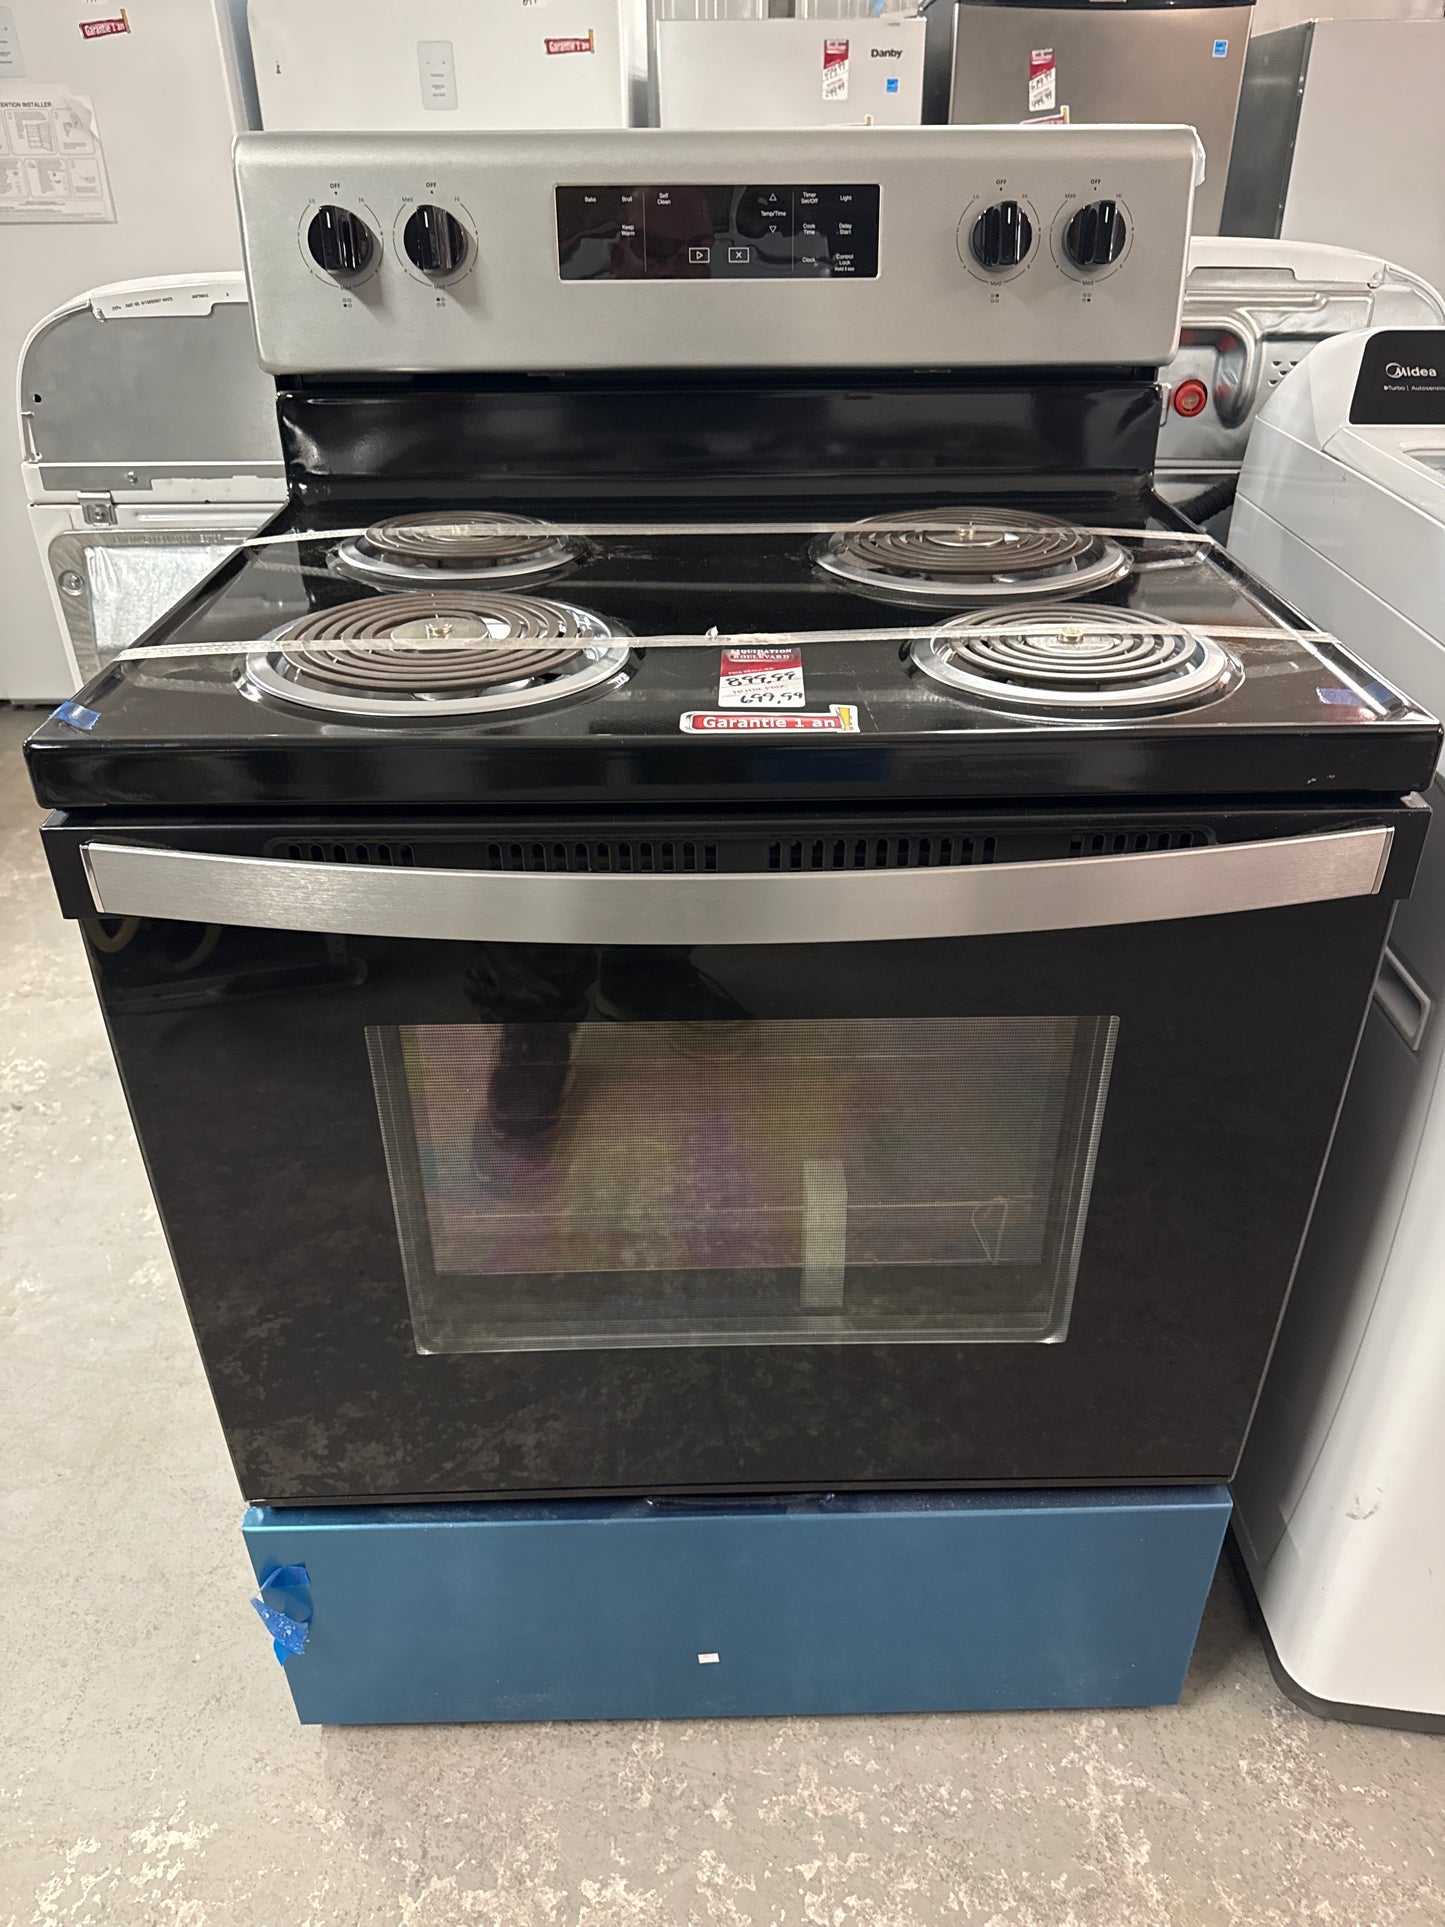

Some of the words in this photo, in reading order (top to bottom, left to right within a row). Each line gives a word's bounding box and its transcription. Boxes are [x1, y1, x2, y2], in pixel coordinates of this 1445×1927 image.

[871, 49, 903, 59] Danby
[1386, 363, 1437, 378] Midea
[726, 671, 796, 687] 899.99
[740, 692, 803, 705] 699.99
[703, 716, 787, 729] Garantie
[795, 717, 804, 728] 1
[811, 718, 836, 728] an
